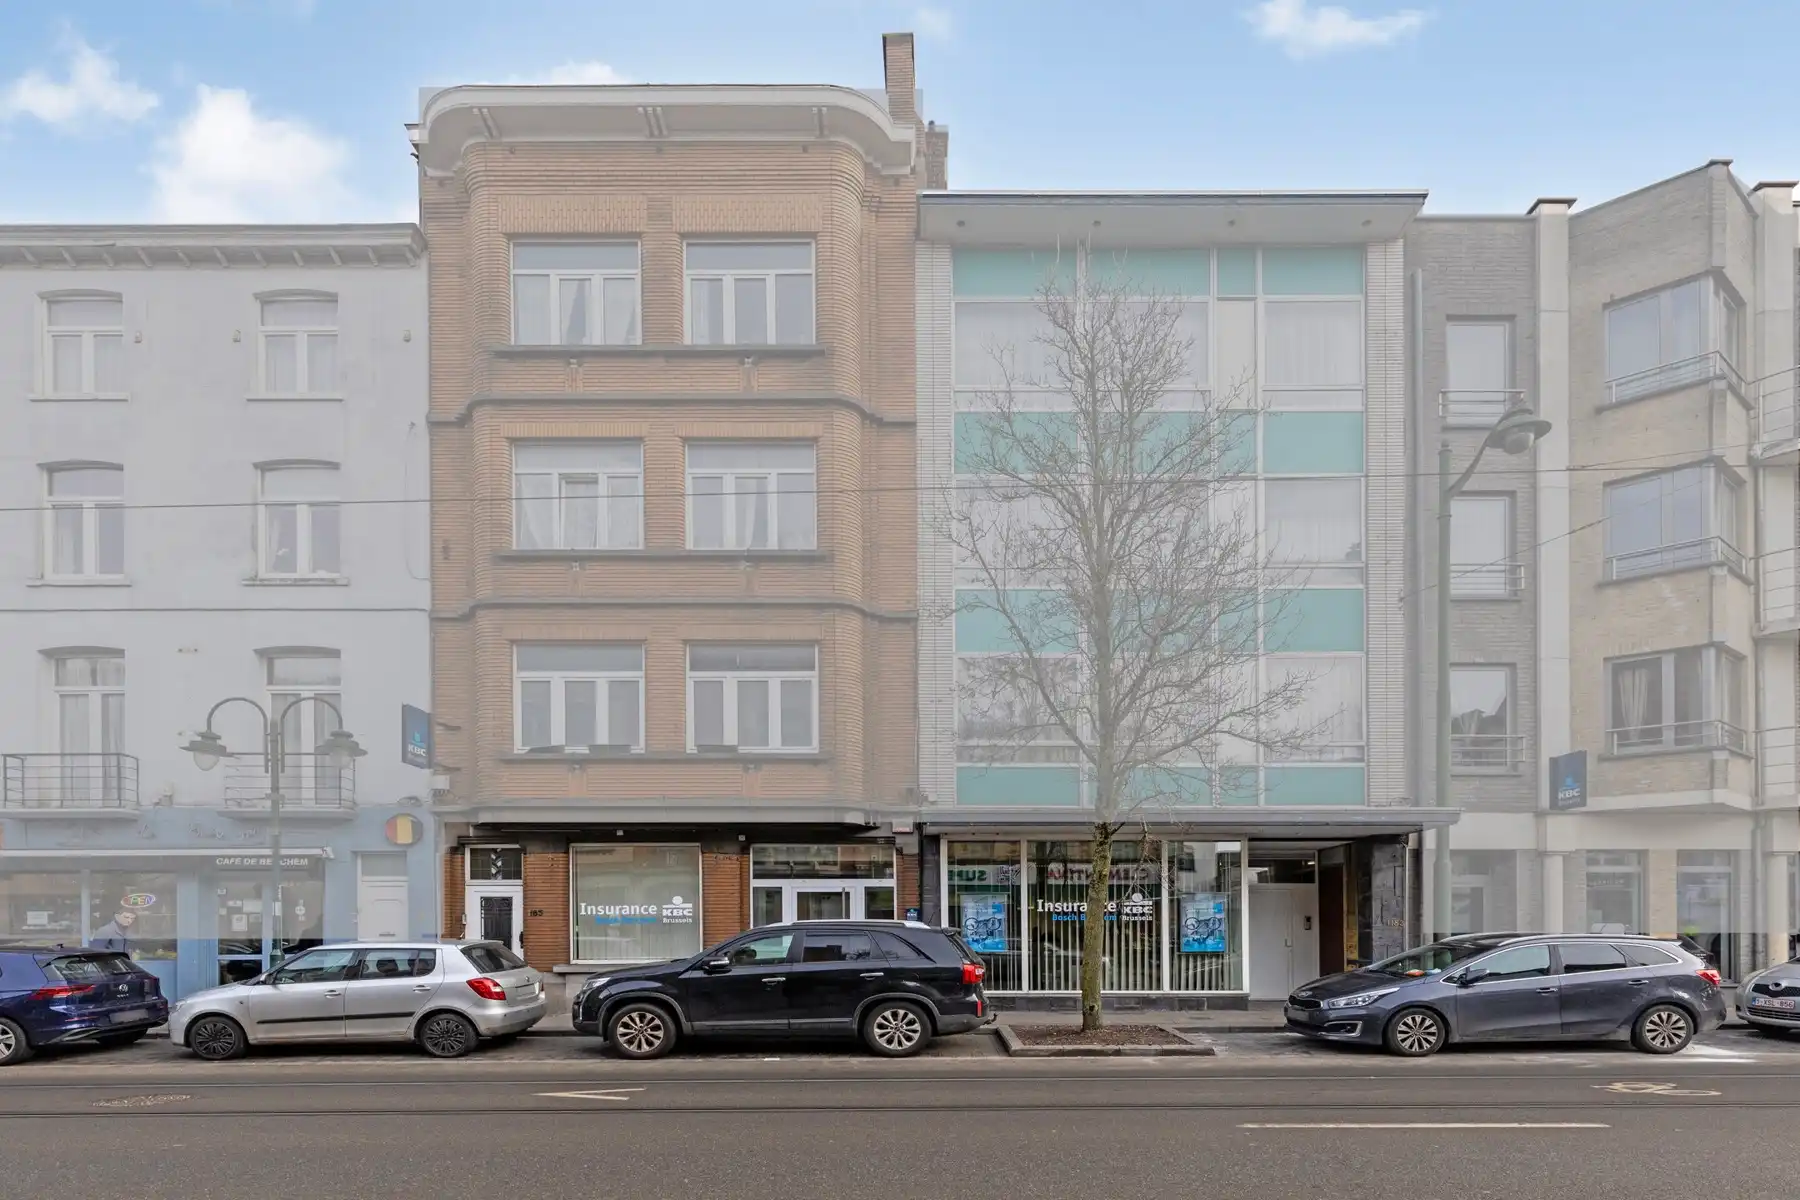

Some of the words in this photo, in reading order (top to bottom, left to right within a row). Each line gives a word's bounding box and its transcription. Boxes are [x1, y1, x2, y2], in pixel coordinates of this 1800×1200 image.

[408, 743, 427, 757] KBC
[1558, 787, 1581, 800] KBC
[243, 857, 258, 866] DE
[259, 857, 309, 866] BECHEM
[579, 902, 658, 916] Insurance
[662, 908, 693, 917] KBC
[1036, 899, 1117, 913] Insurae
[1123, 905, 1153, 914] KBC
